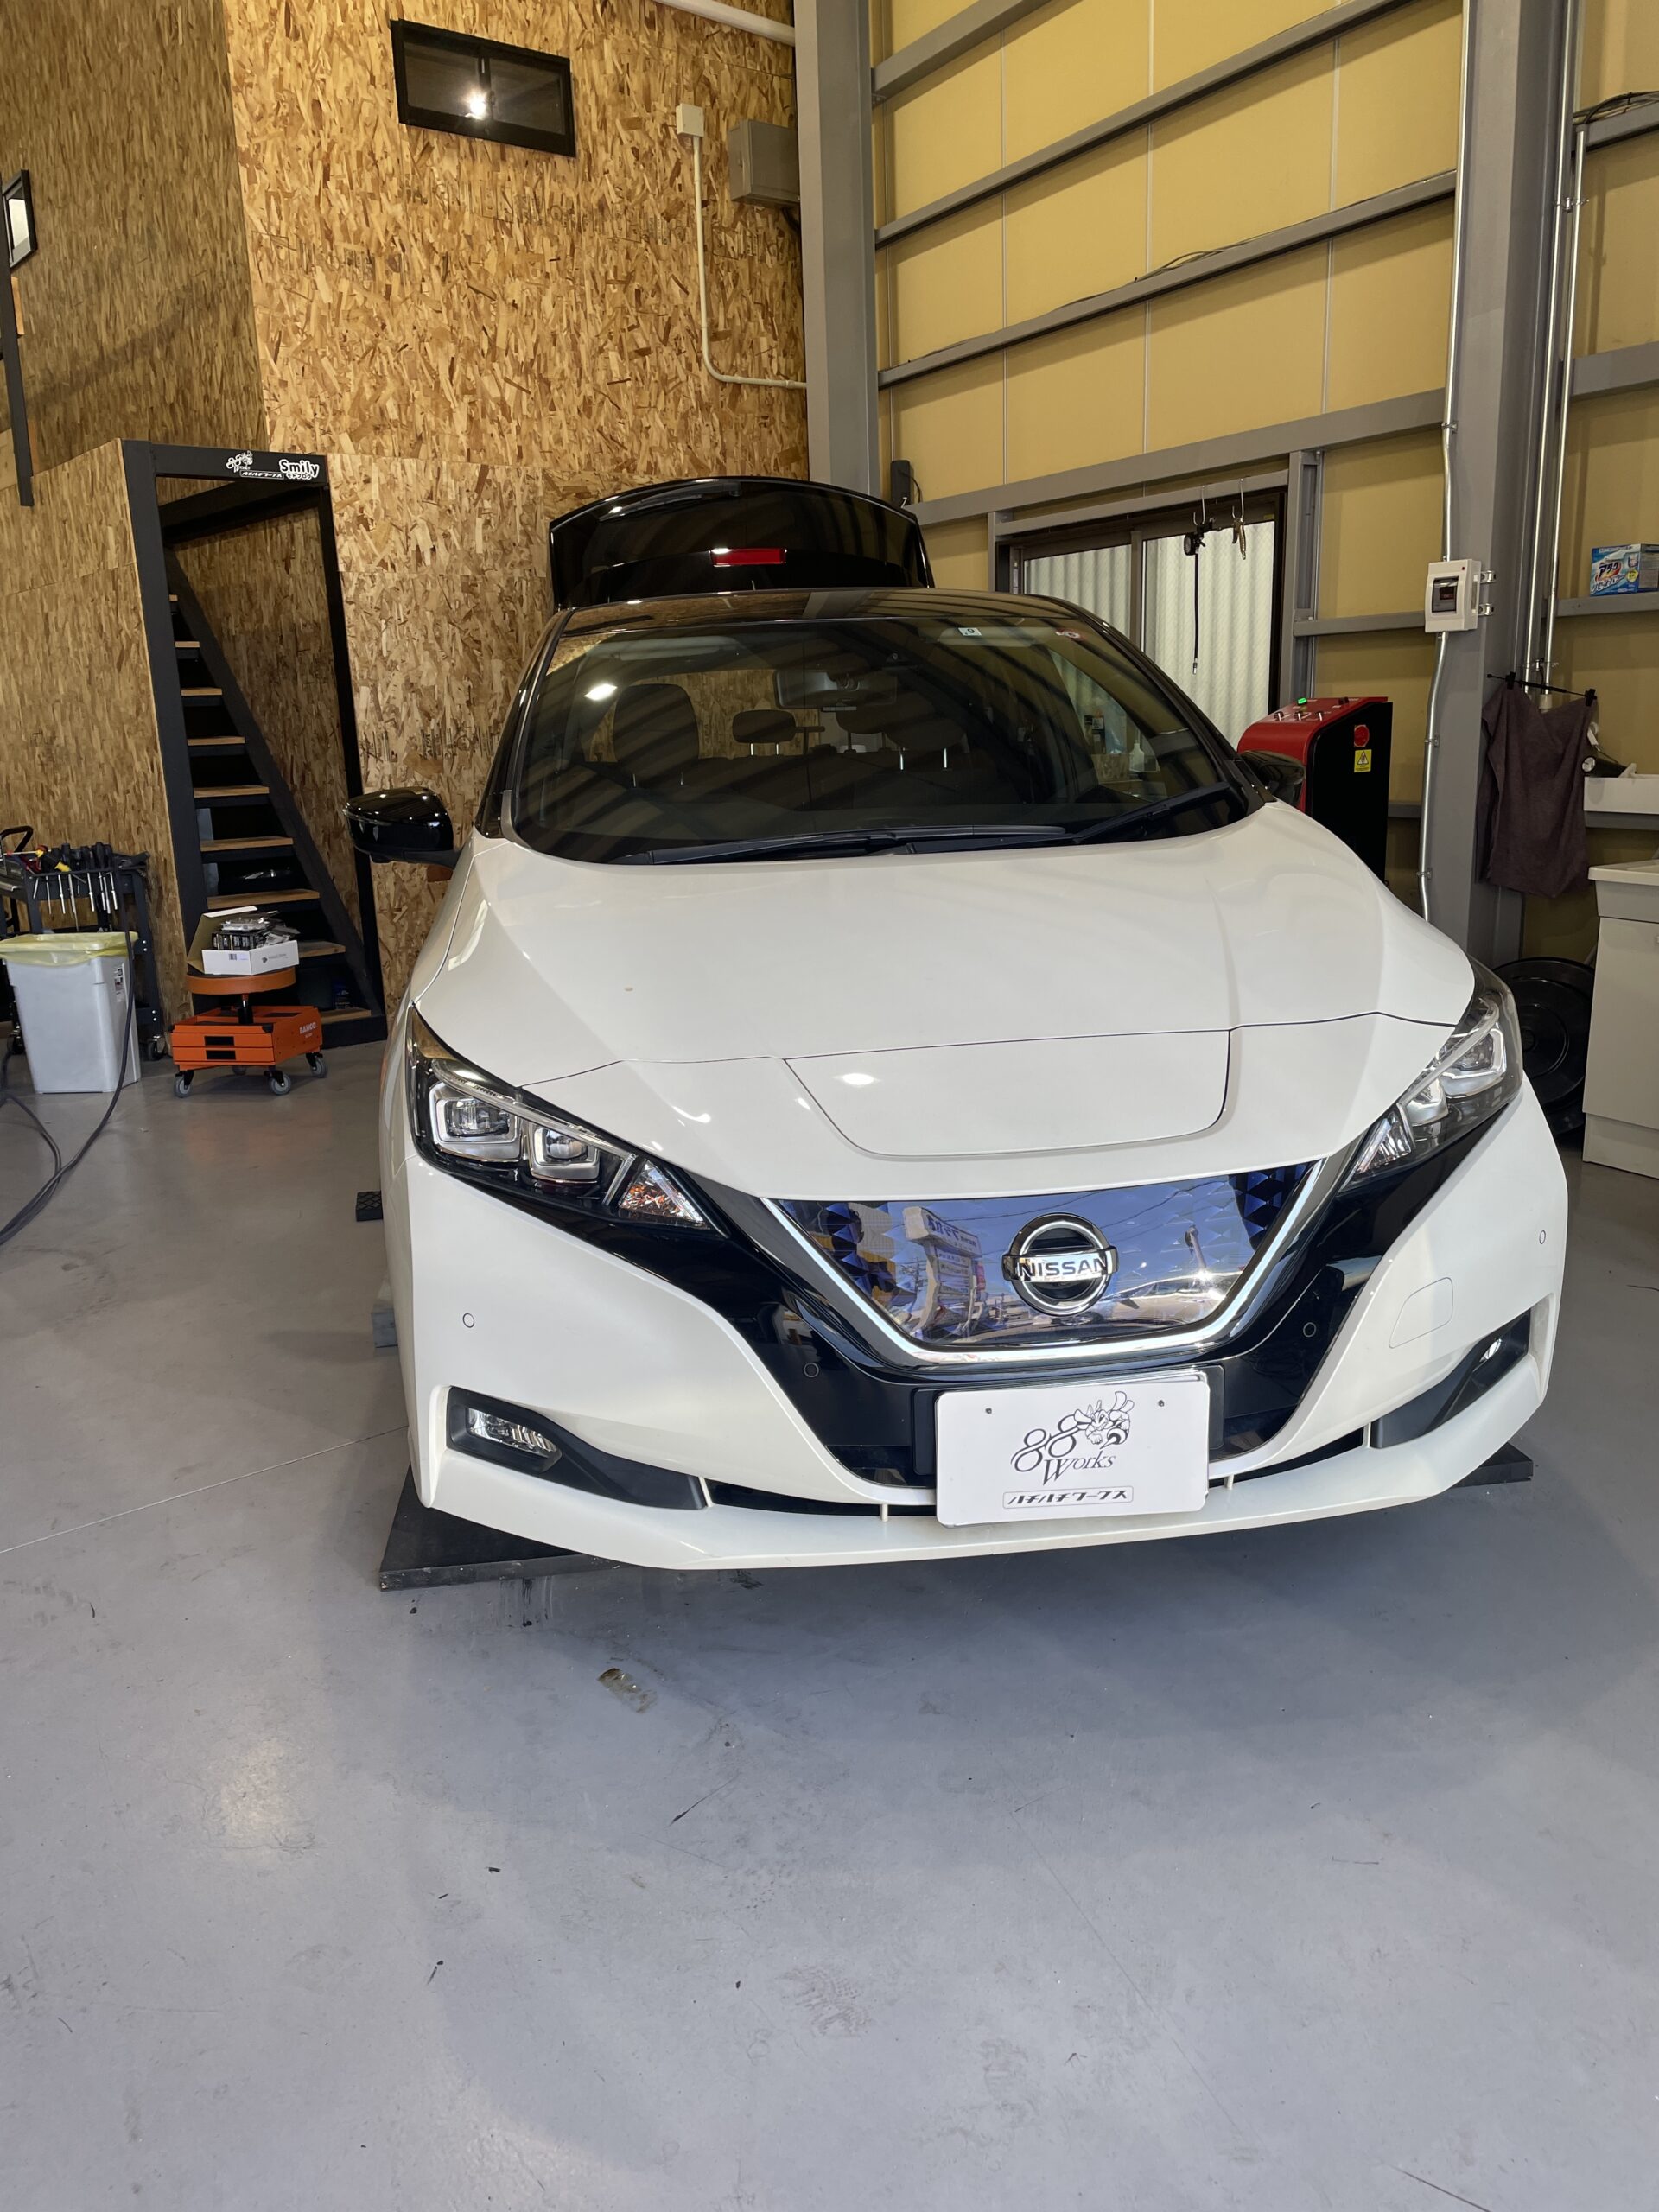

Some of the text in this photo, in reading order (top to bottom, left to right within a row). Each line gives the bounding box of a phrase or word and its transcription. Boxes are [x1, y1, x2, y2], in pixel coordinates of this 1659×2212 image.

[279, 459, 320, 478] Smily
[1020, 1258, 1107, 1277] NISSAN
[1010, 1414, 1116, 1486] 88 Works
[1007, 1490, 1128, 1505] ハチハチワークス
